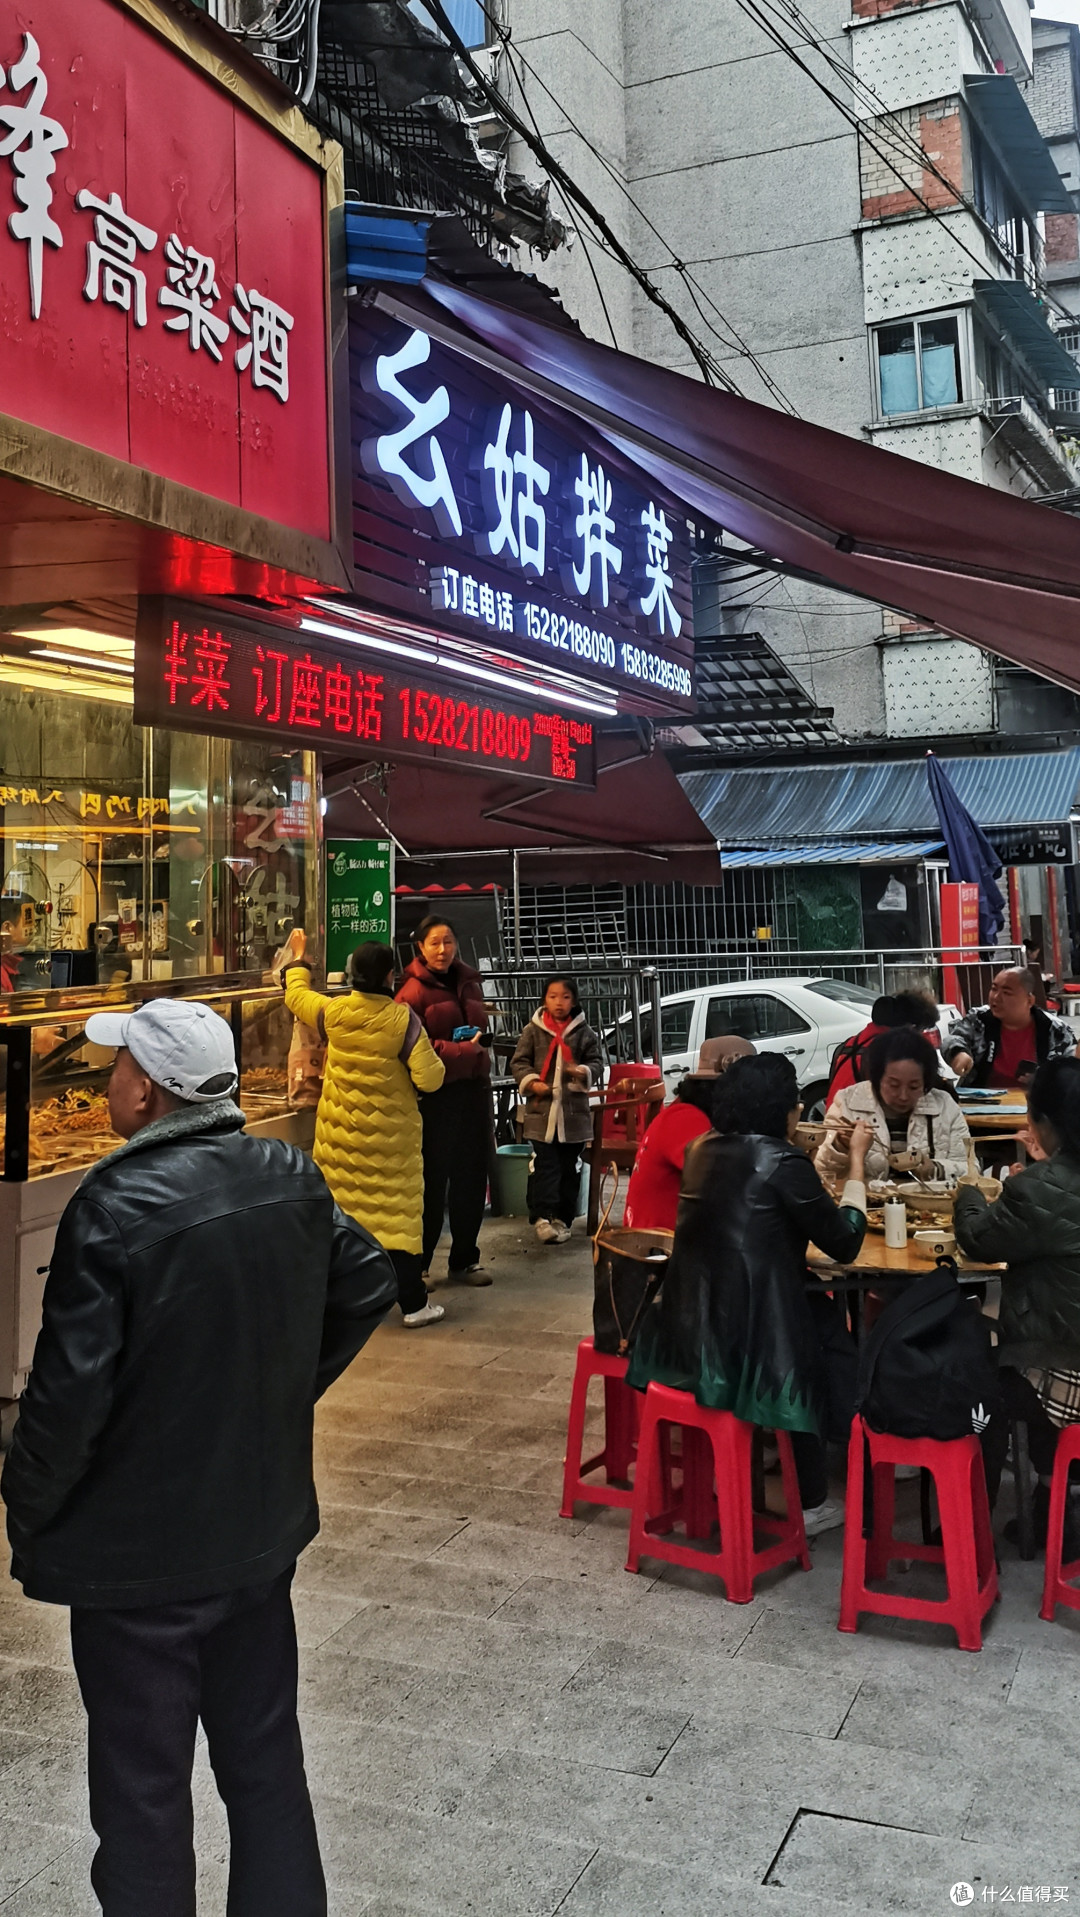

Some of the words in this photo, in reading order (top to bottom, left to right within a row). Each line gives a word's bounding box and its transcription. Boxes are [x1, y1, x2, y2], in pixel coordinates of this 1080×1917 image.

[441, 565, 514, 633] 订座电话
[524, 602, 616, 668] 15282188090
[621, 643, 692, 697] 15883285996
[252, 644, 385, 741] 订座电话
[398, 687, 532, 762] 1528218809
[331, 918, 387, 934] 不一样的活力
